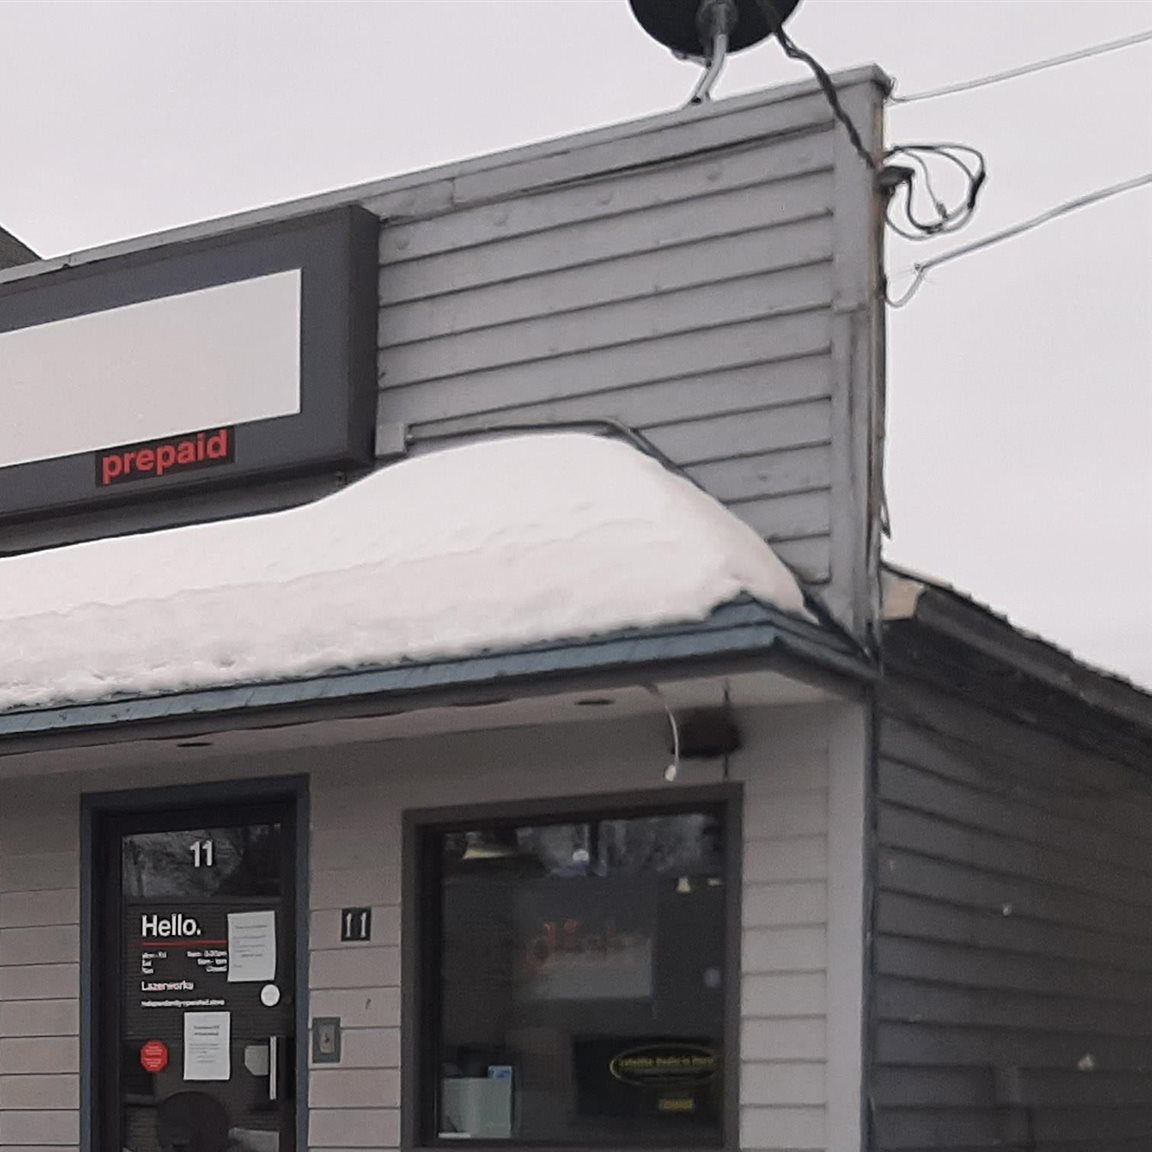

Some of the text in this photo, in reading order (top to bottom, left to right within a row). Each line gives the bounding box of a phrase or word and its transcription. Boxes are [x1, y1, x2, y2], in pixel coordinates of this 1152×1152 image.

[102, 428, 228, 485] prepaid
[189, 839, 214, 868] 11
[141, 913, 202, 937] Hello.
[345, 912, 367, 938] 11
